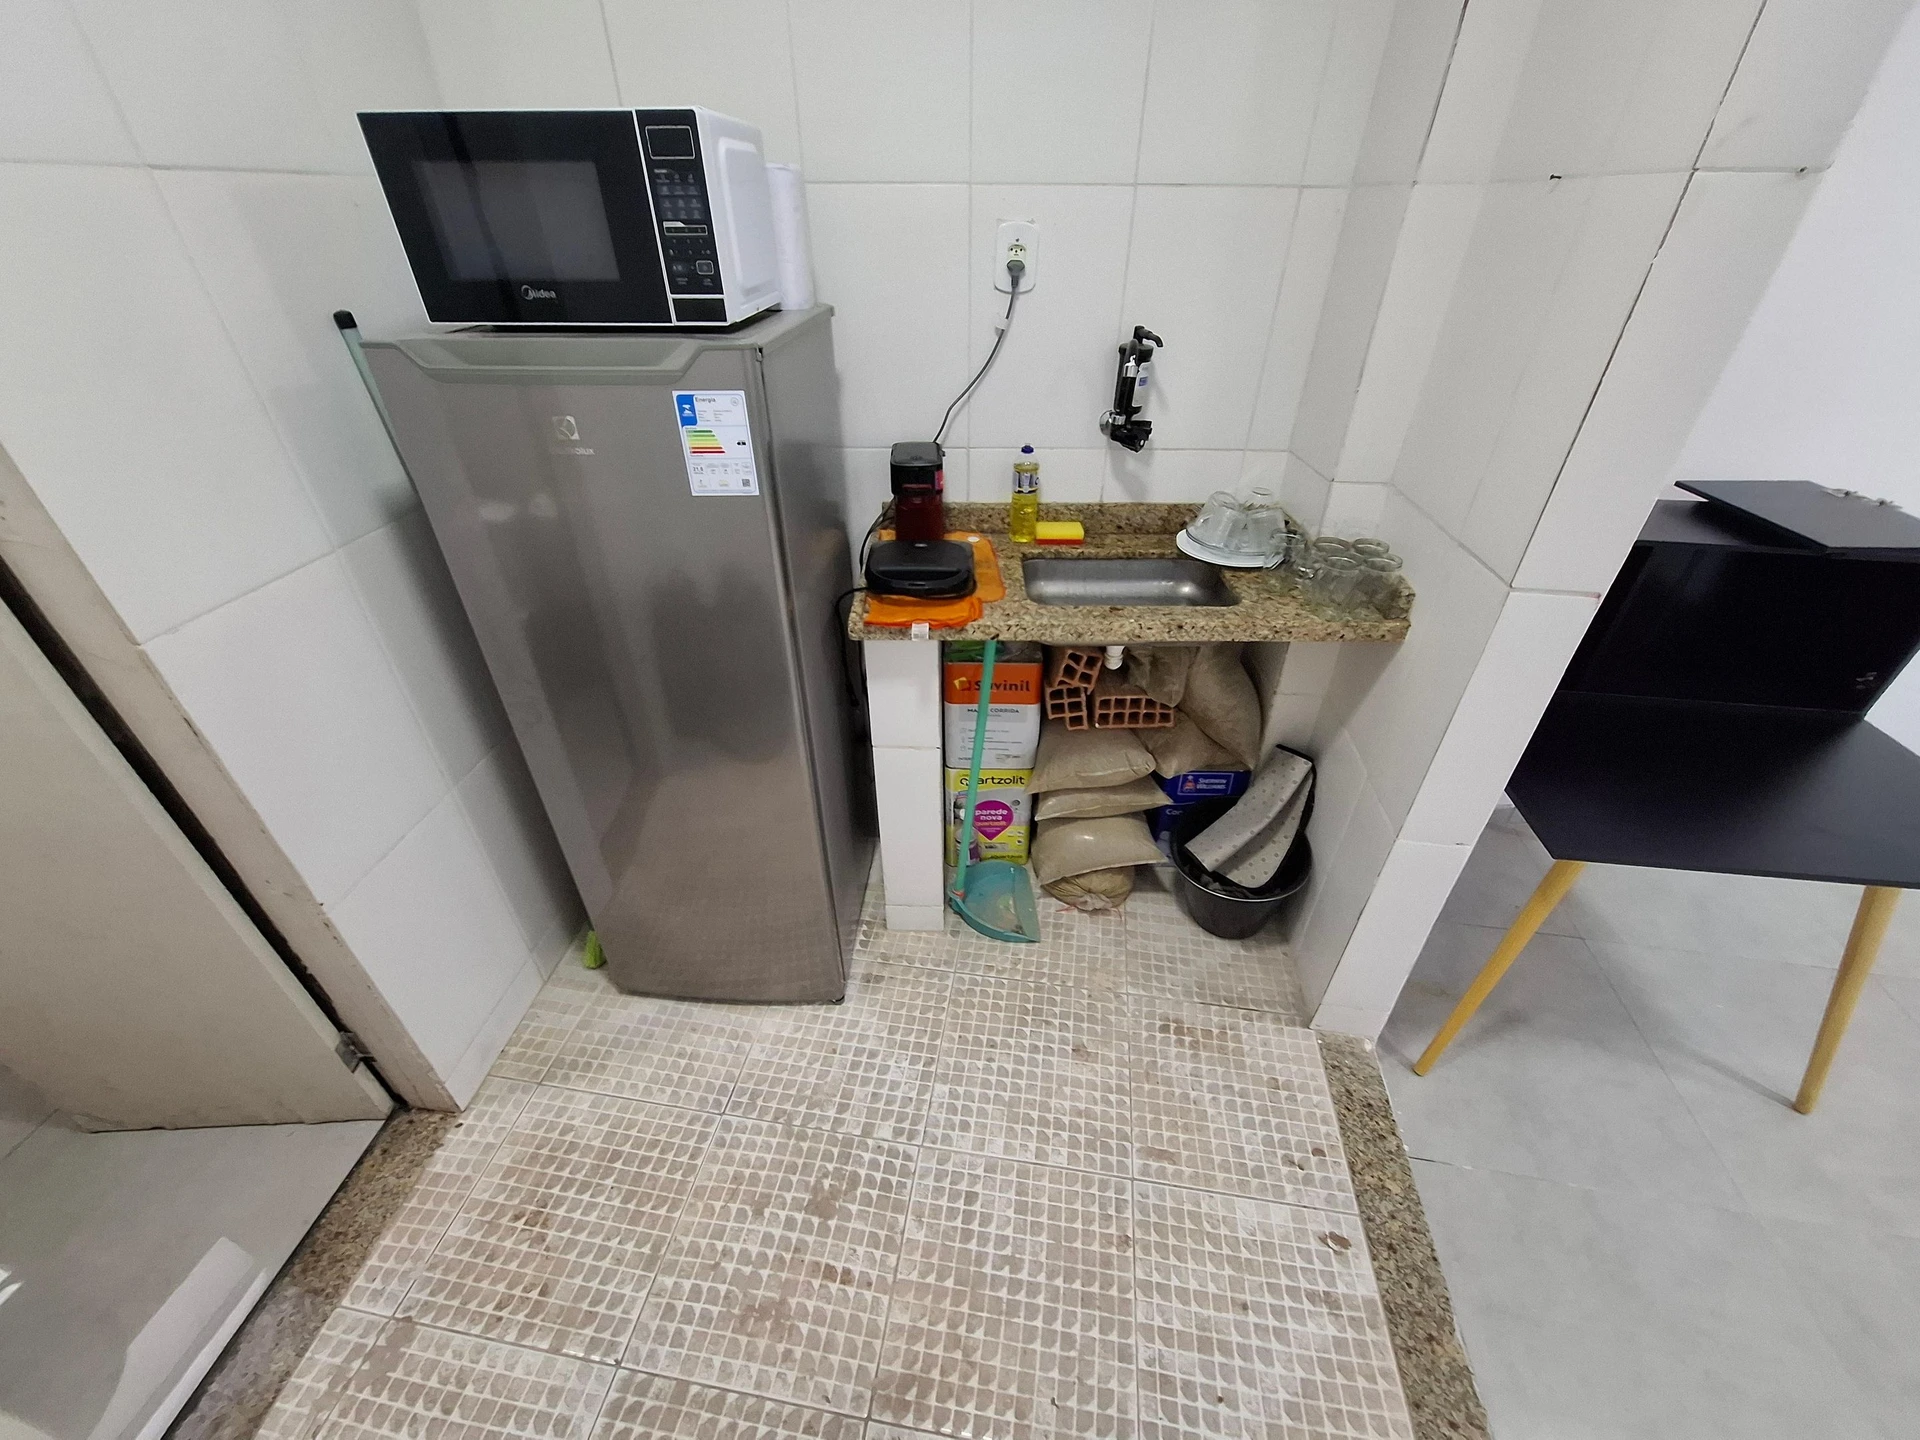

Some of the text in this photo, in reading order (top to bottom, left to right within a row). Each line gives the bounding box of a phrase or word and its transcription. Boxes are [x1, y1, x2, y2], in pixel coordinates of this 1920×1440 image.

[521, 284, 557, 300] Midea
[694, 396, 716, 404] Energia
[974, 680, 1031, 692] Svinil
[960, 776, 1025, 786] qartzolit
